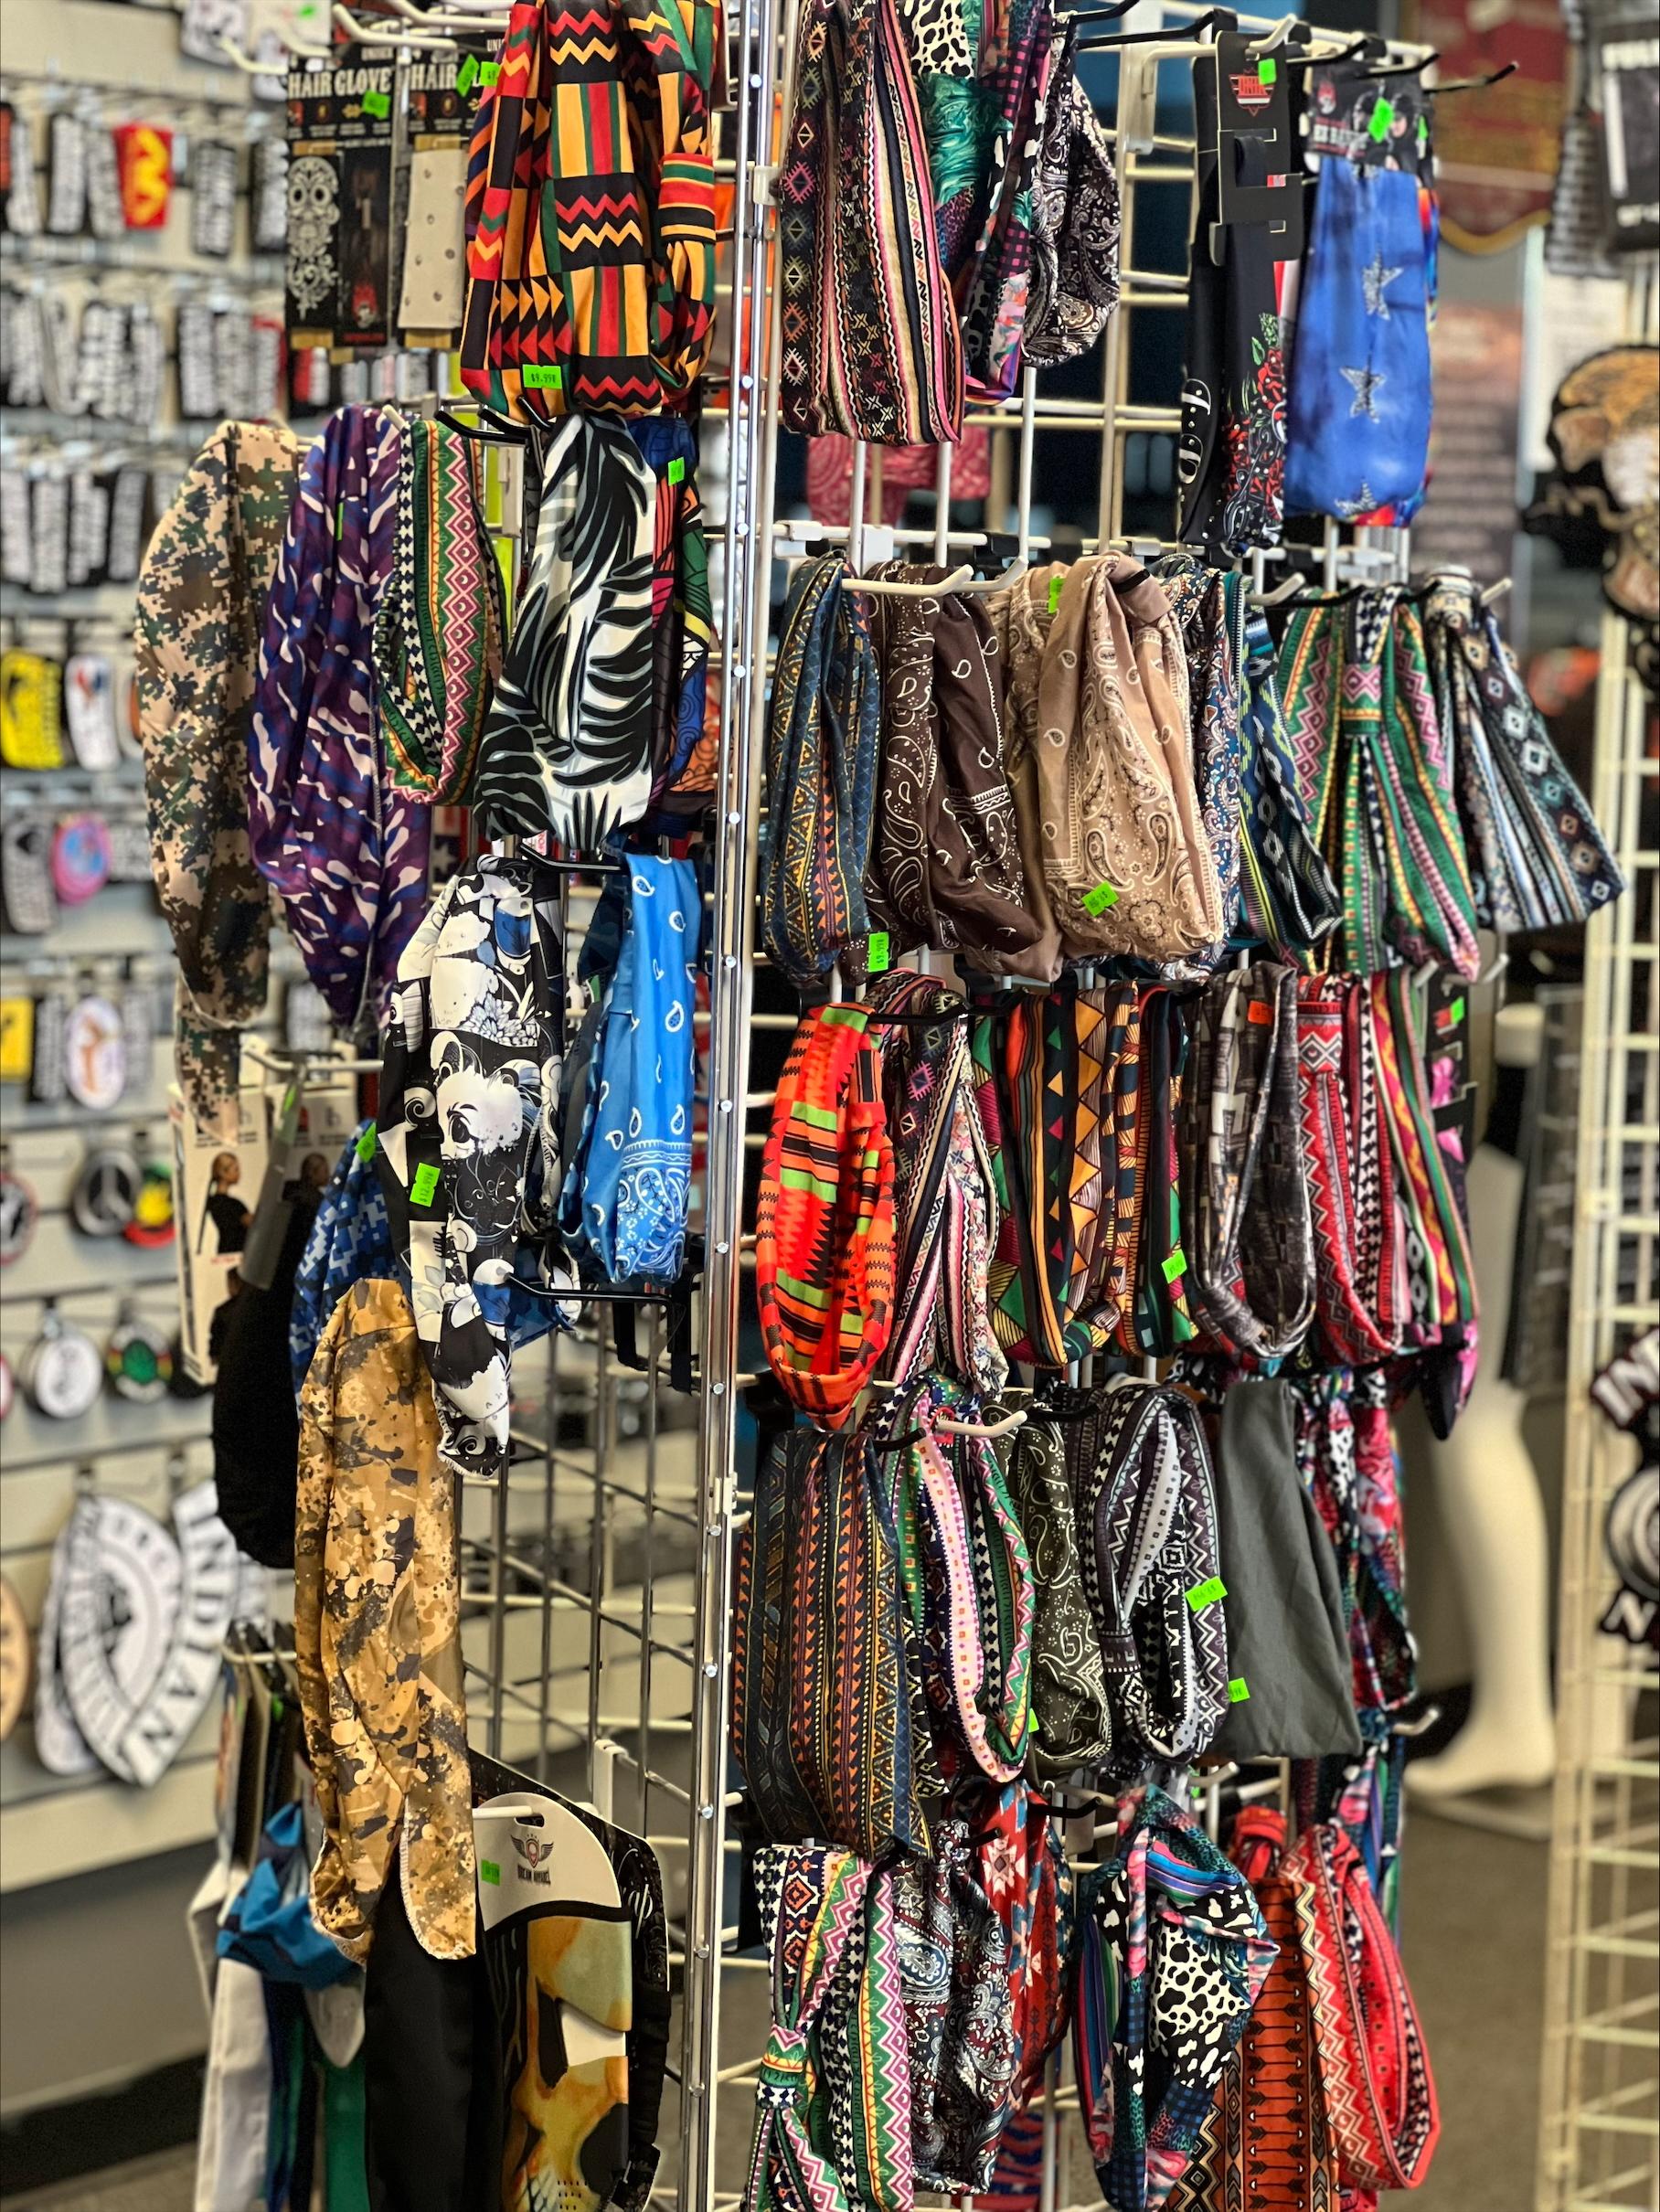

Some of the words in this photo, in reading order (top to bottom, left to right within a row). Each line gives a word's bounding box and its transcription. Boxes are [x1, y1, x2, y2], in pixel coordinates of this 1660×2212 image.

[288, 70, 333, 100] HAIR
[335, 69, 391, 95] GLOVE
[411, 62, 457, 90] HAIR
[124, 1480, 236, 1788] INDIAN
